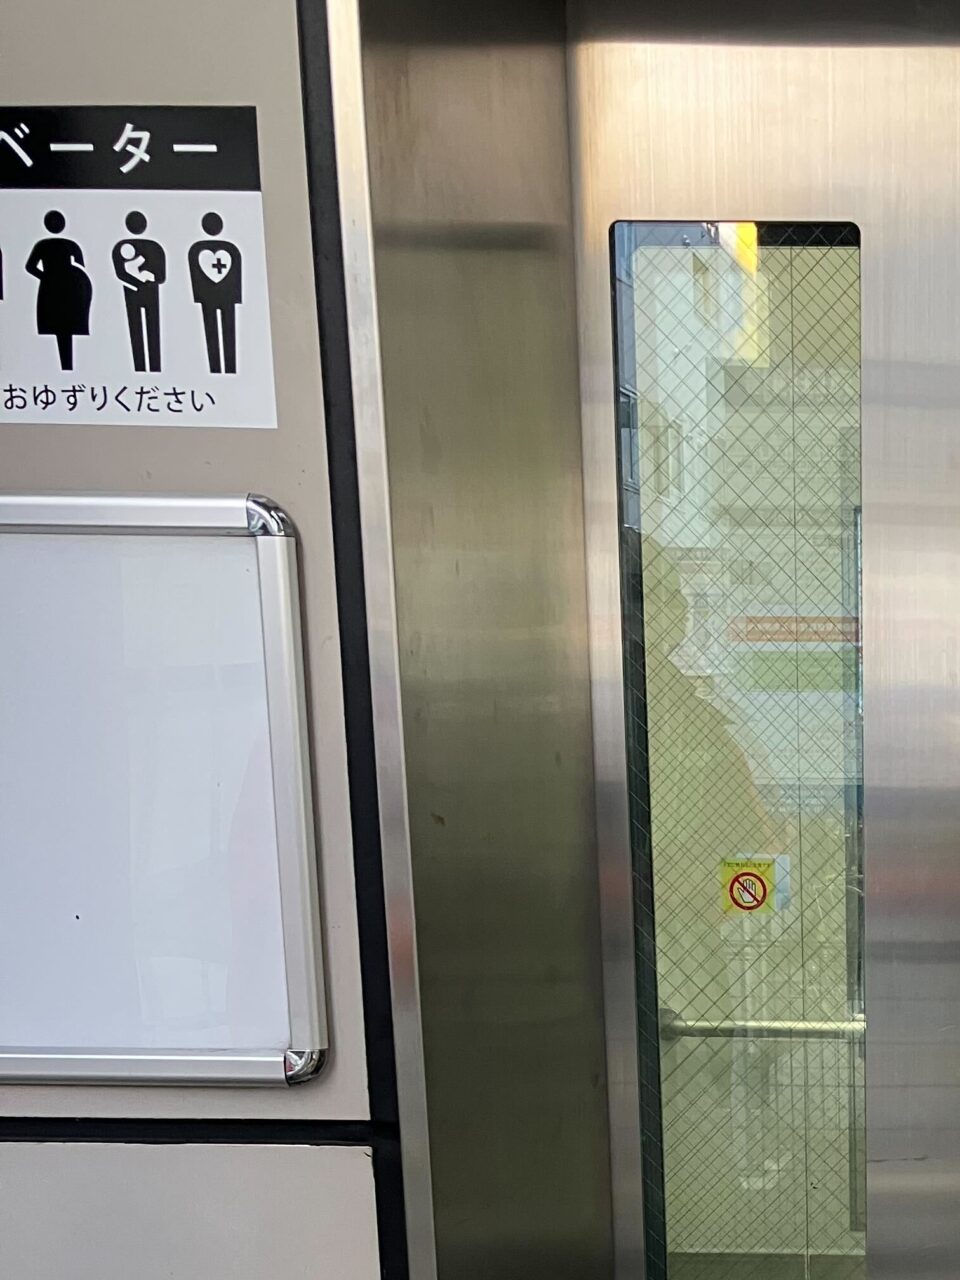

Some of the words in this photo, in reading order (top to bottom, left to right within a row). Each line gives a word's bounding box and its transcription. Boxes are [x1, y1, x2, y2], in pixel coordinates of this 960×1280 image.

[2, 383, 216, 413] おゆずりください
